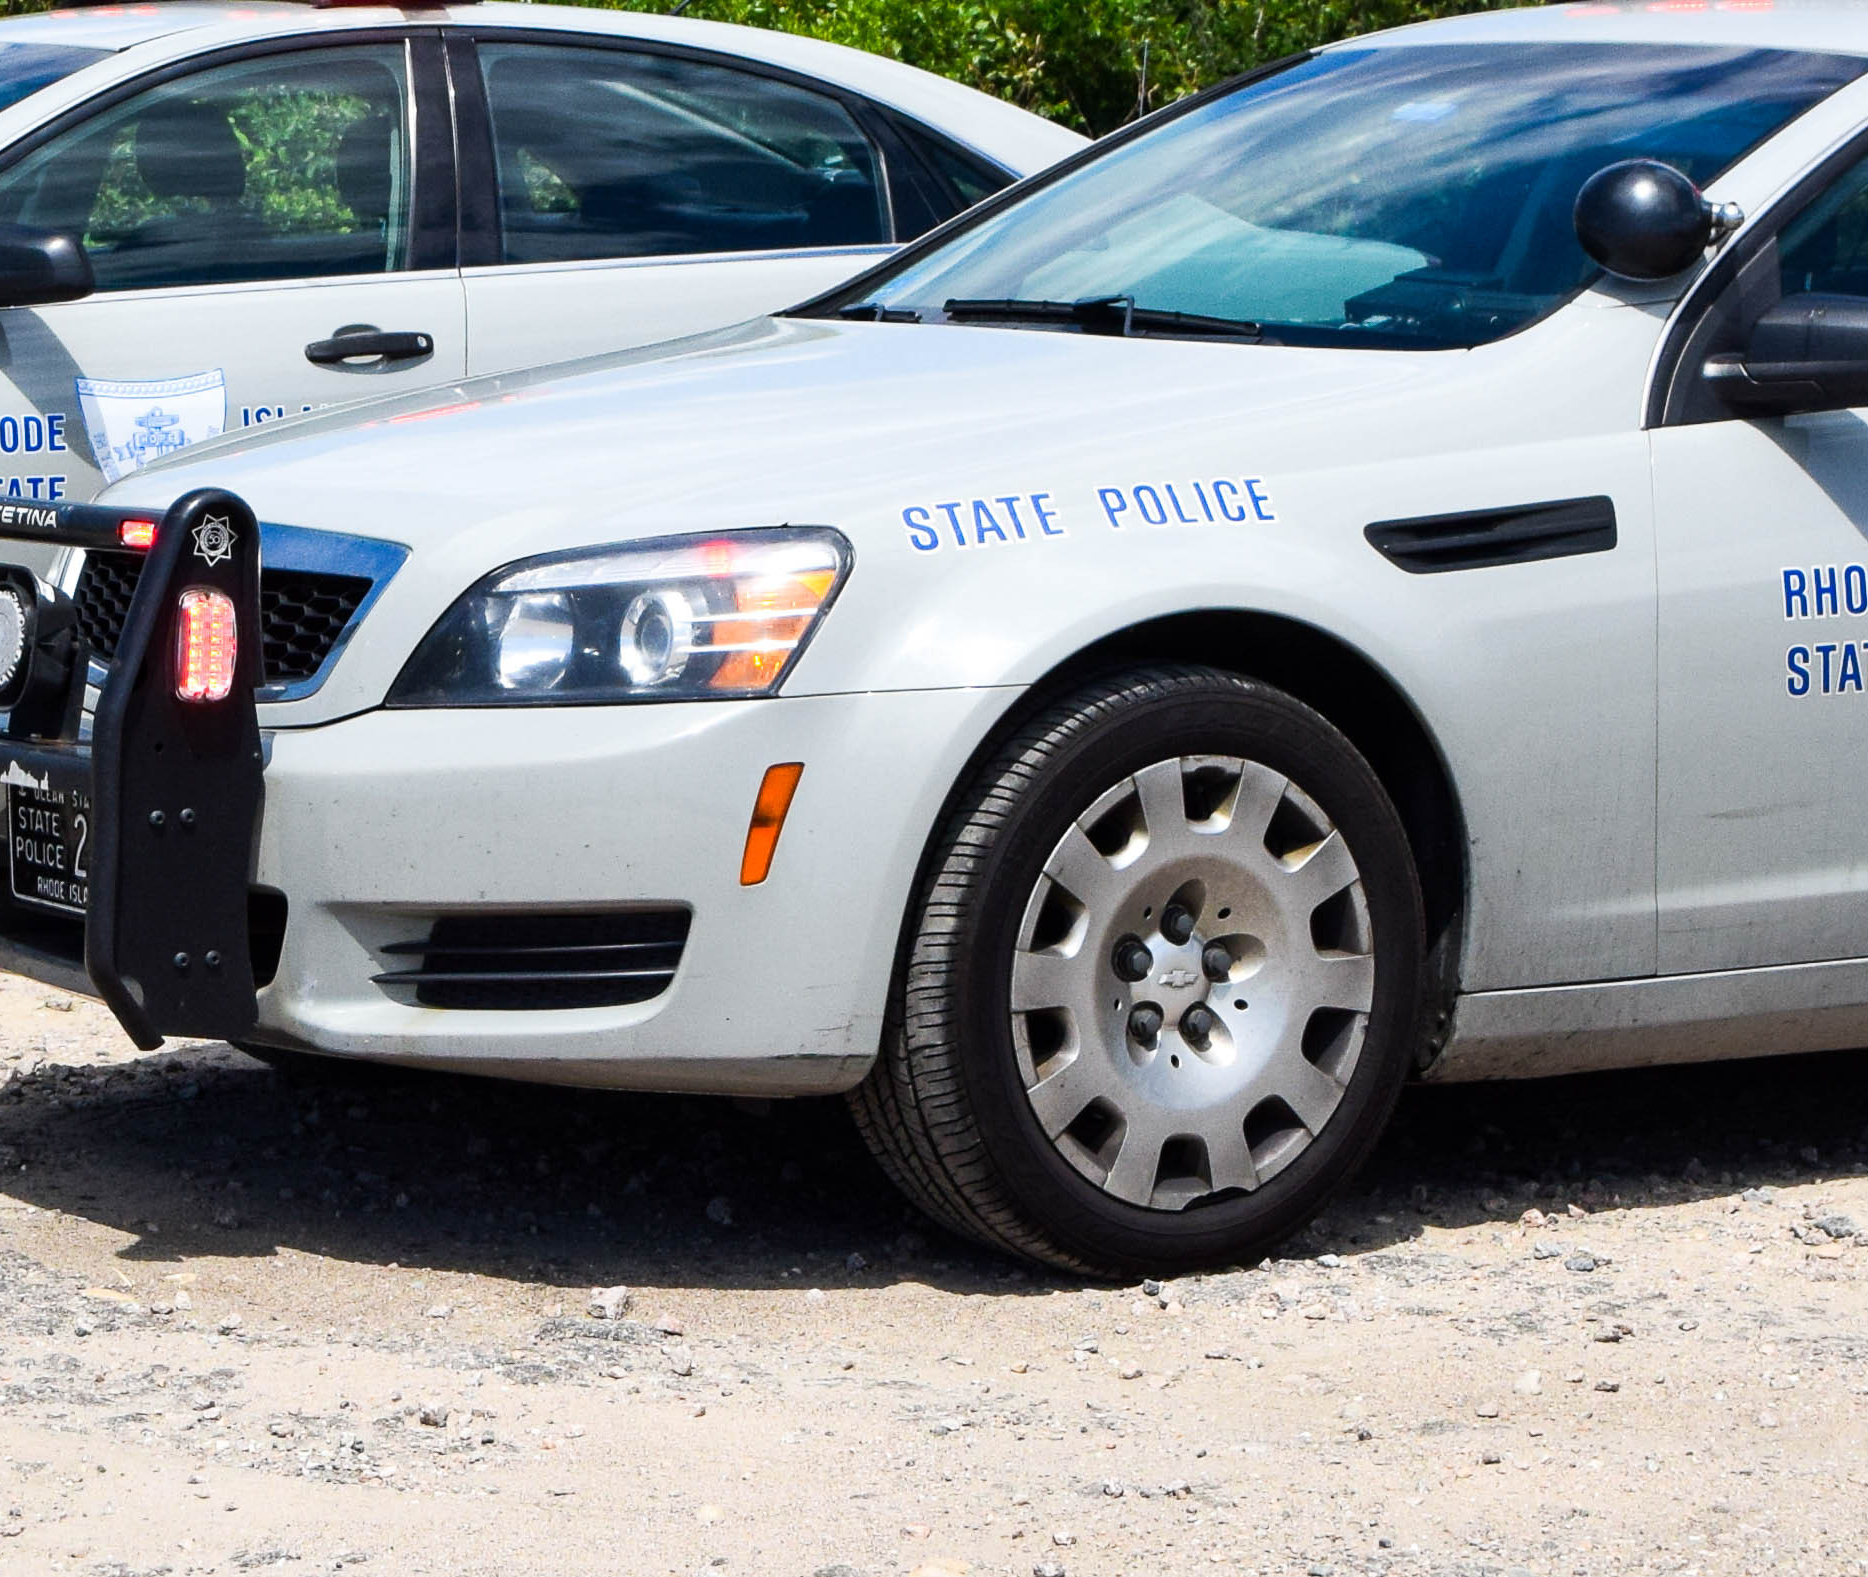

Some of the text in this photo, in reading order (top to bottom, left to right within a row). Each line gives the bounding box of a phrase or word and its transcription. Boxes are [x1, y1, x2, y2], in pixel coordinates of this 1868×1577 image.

[902, 479, 1275, 551] STATE POLICE
[18, 806, 60, 837] STATE
[16, 836, 65, 869] POLICE
[37, 875, 65, 900] RHODE
